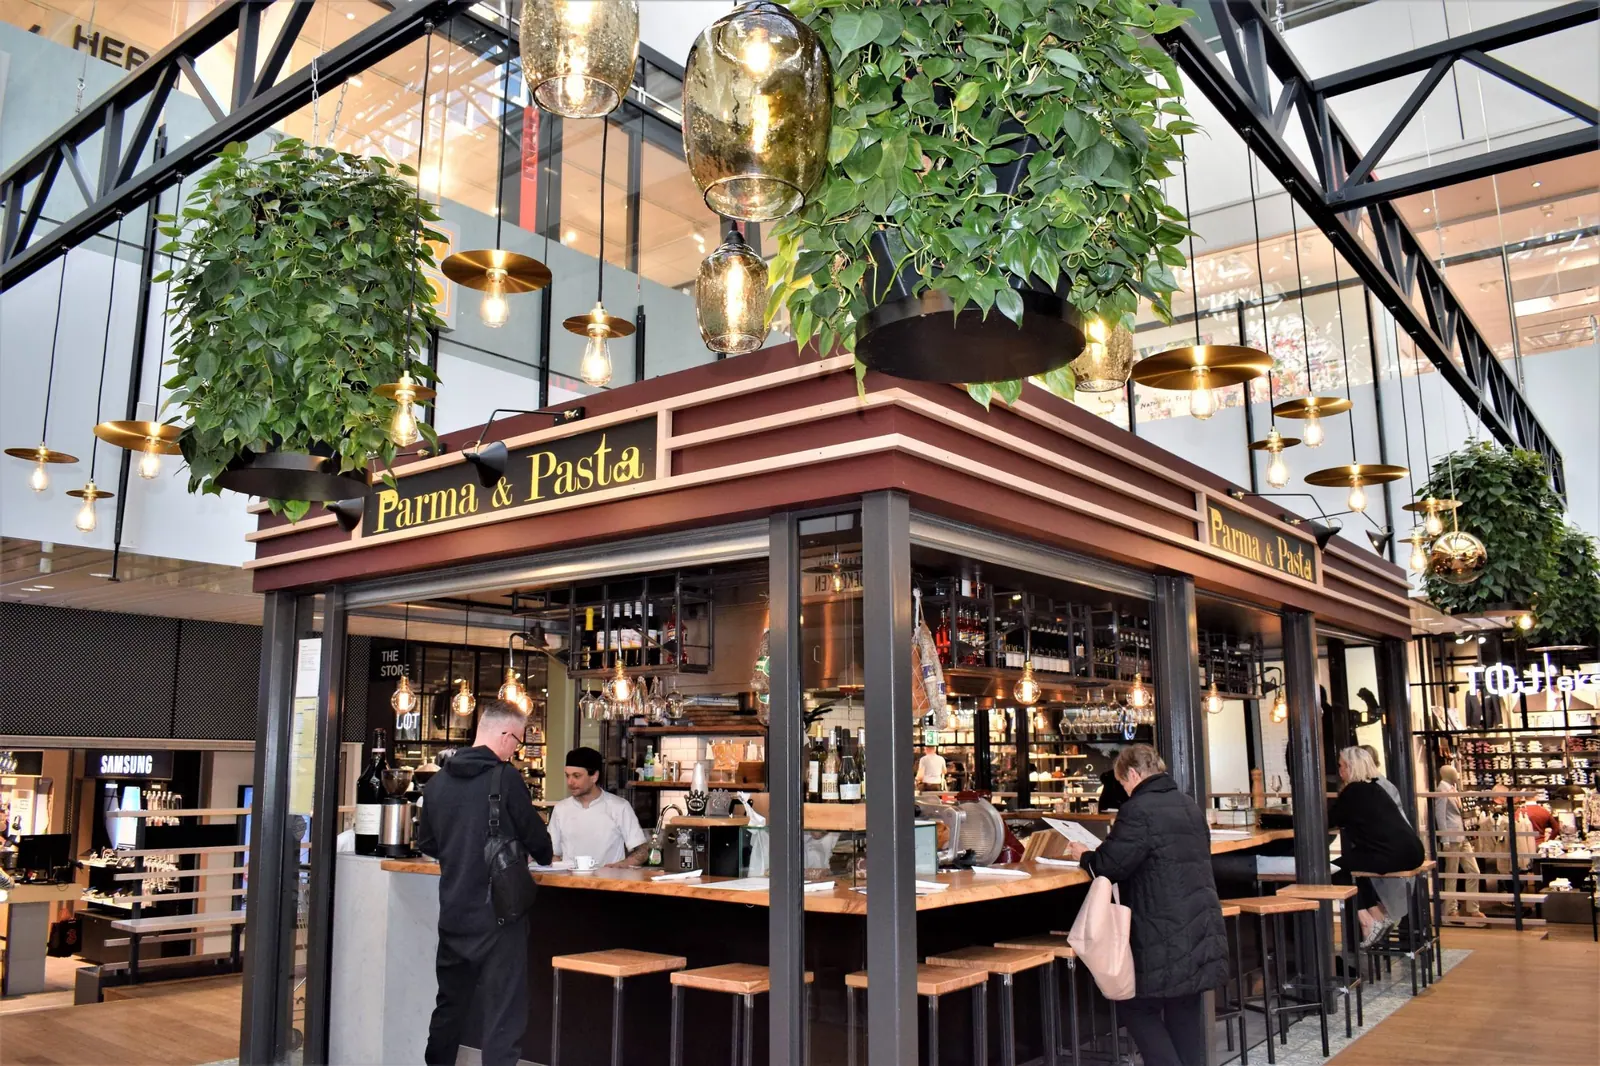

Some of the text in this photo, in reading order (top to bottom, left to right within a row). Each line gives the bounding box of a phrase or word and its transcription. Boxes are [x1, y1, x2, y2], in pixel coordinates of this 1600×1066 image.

[373, 433, 645, 534] Parma & Pasta
[1208, 506, 1313, 581] Parma & Pasta
[381, 649, 399, 662] THE
[380, 663, 410, 677] STORE
[100, 754, 153, 774] SAMSUNG
